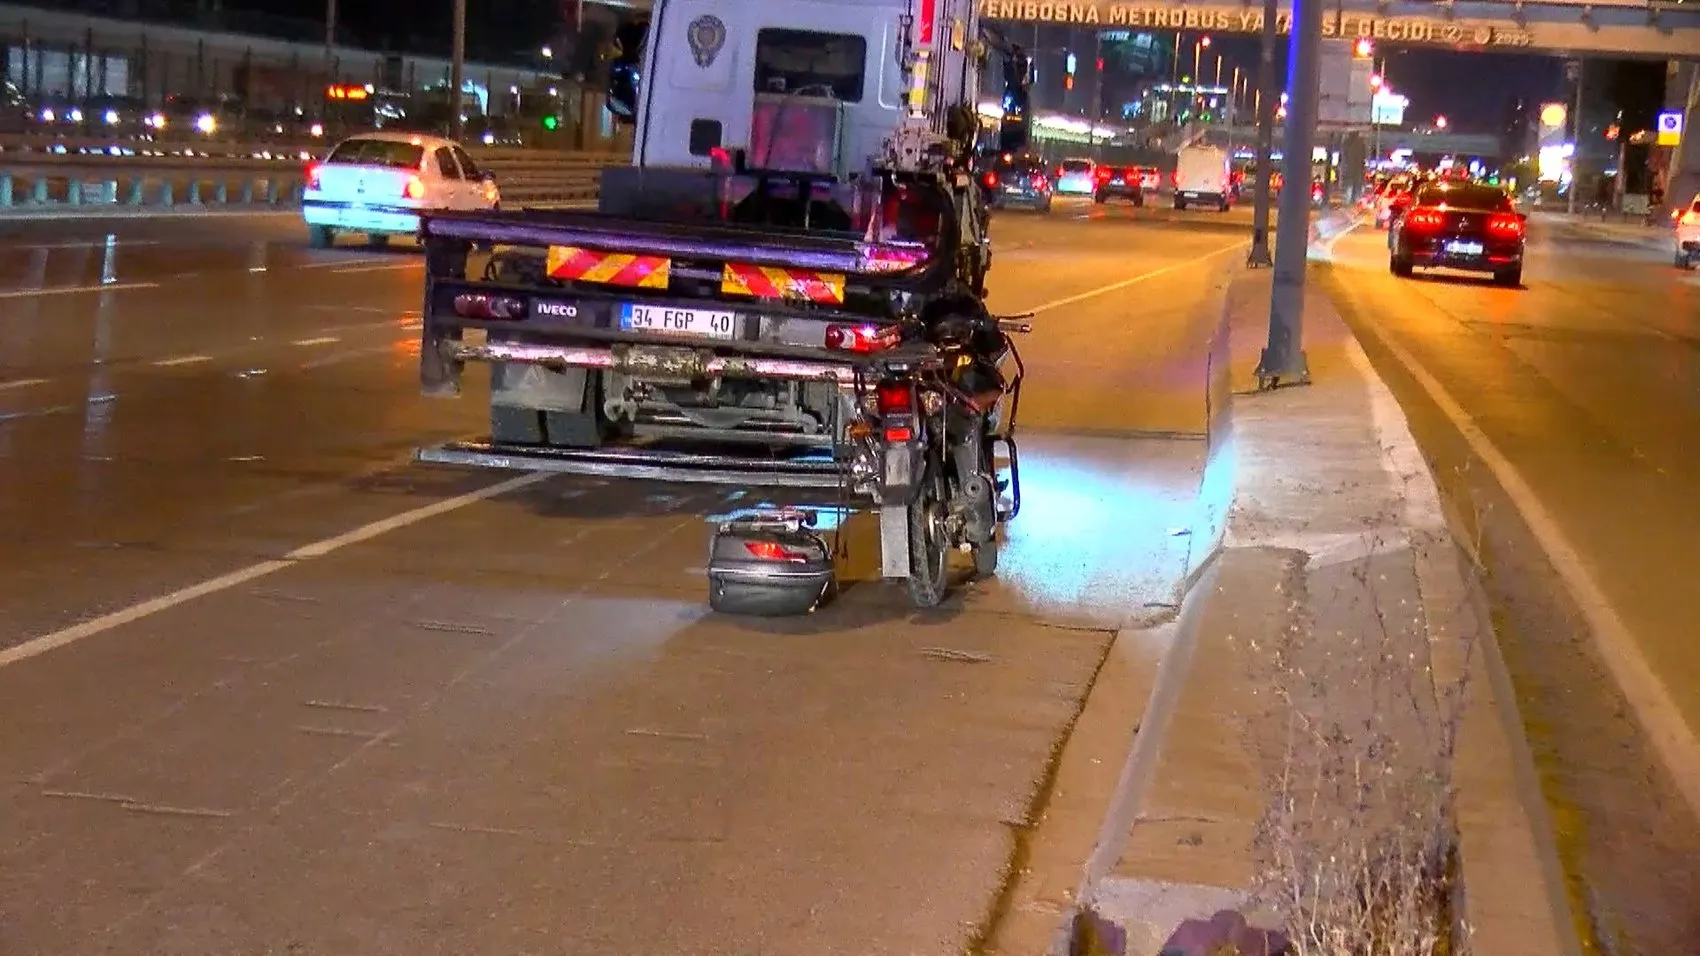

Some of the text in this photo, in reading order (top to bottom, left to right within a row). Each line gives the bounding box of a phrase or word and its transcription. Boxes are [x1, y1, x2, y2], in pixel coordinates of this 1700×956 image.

[537, 303, 577, 318] IVECO
[633, 308, 652, 326] 34
[664, 310, 694, 330] FGP
[710, 314, 730, 332] 40
